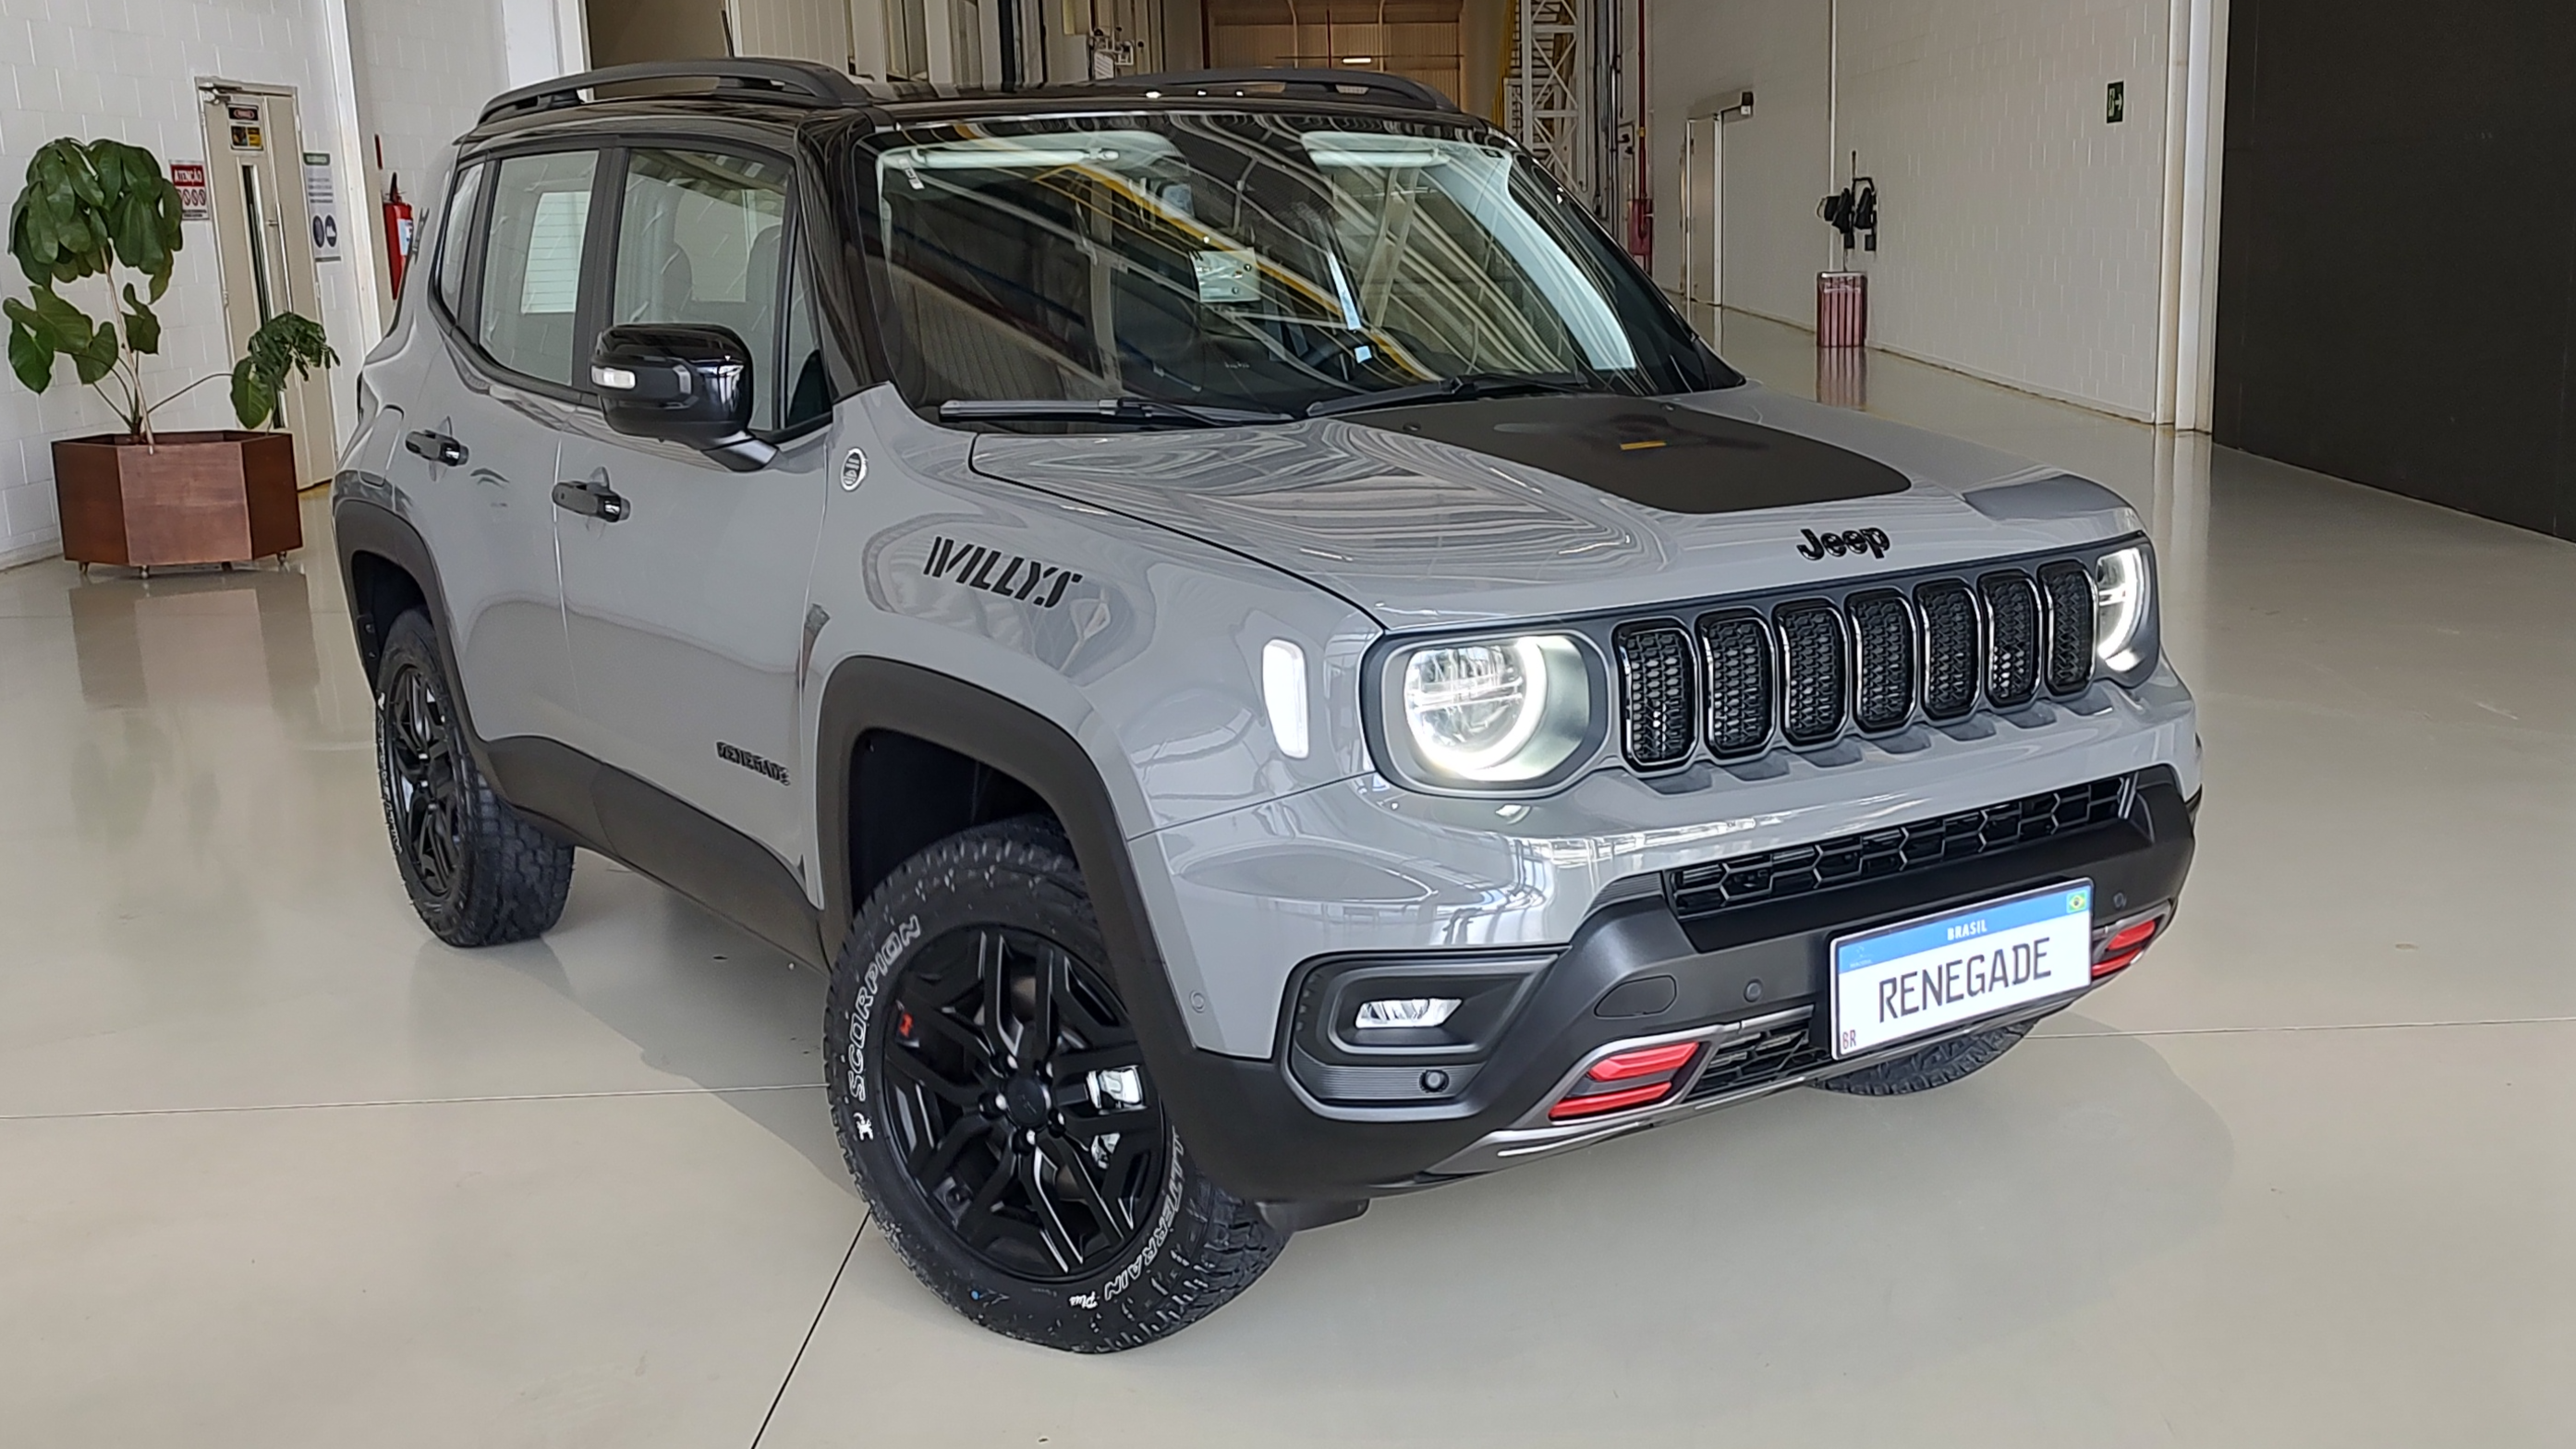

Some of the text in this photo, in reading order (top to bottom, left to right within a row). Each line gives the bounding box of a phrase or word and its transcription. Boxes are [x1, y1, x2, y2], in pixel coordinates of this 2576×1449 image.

[1796, 528, 1890, 561] Jeep
[923, 536, 1083, 608] WILLYS
[716, 741, 791, 786] RENEGADE
[1947, 919, 1987, 941] BRASIL
[1878, 937, 2052, 1023] RENEGADE
[848, 914, 921, 1102] SCORPION
[1842, 1029, 1857, 1050] BR
[1069, 1291, 1099, 1309] Plus
